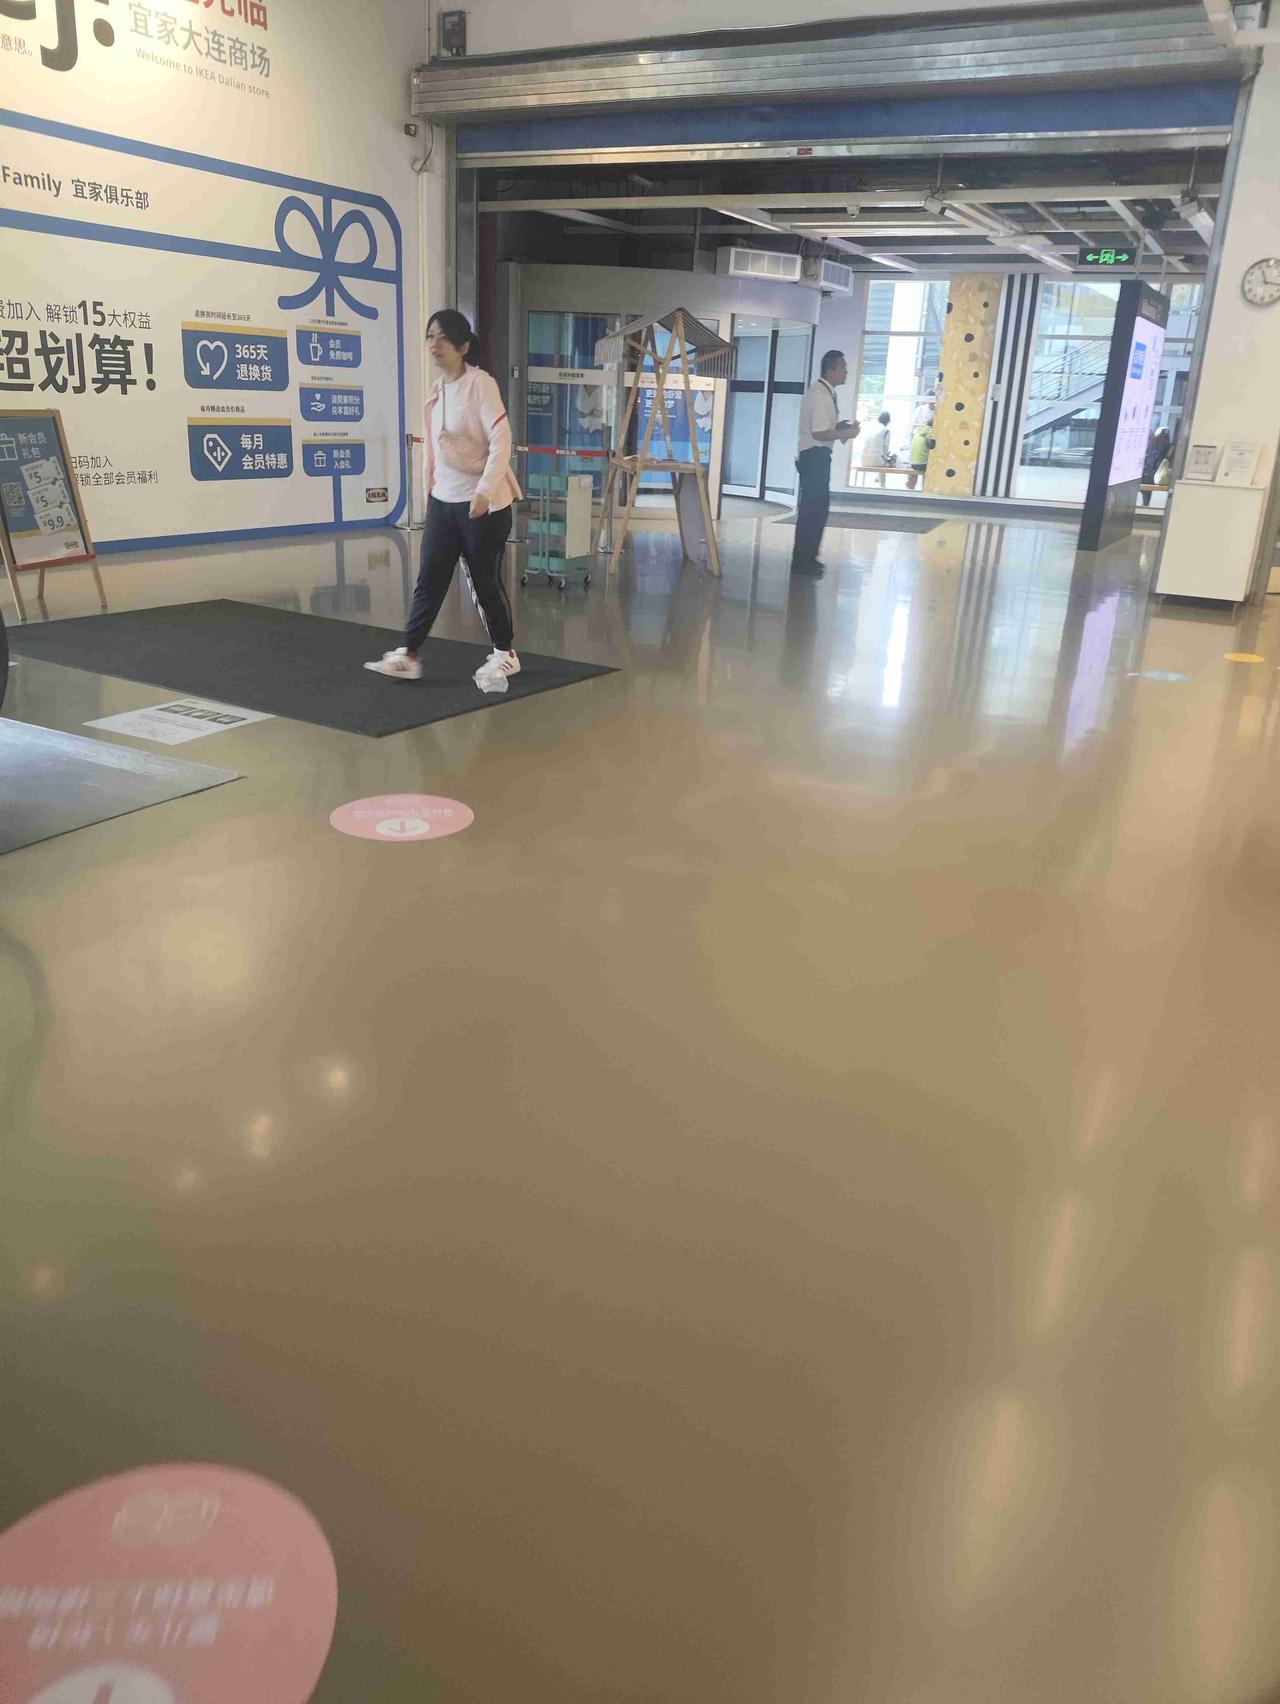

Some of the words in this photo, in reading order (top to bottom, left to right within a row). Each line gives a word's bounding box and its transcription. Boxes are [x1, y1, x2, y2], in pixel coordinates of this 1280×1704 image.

[128, 2, 271, 79] 宜家大连商场
[135, 47, 181, 72] Welcome
[183, 62, 194, 74] to
[195, 66, 216, 82] IKEA
[218, 73, 246, 92] Dalian
[248, 84, 270, 99] store
[1, 165, 62, 198] Family
[71, 178, 150, 210] 宜家俱乐部
[45, 299, 152, 330] 解锁15大权益
[235, 343, 269, 361] 365天
[236, 364, 273, 382] 退换货
[240, 433, 264, 450] 每月
[241, 453, 288, 471] 会员特惠
[367, 491, 387, 499] IKEA
